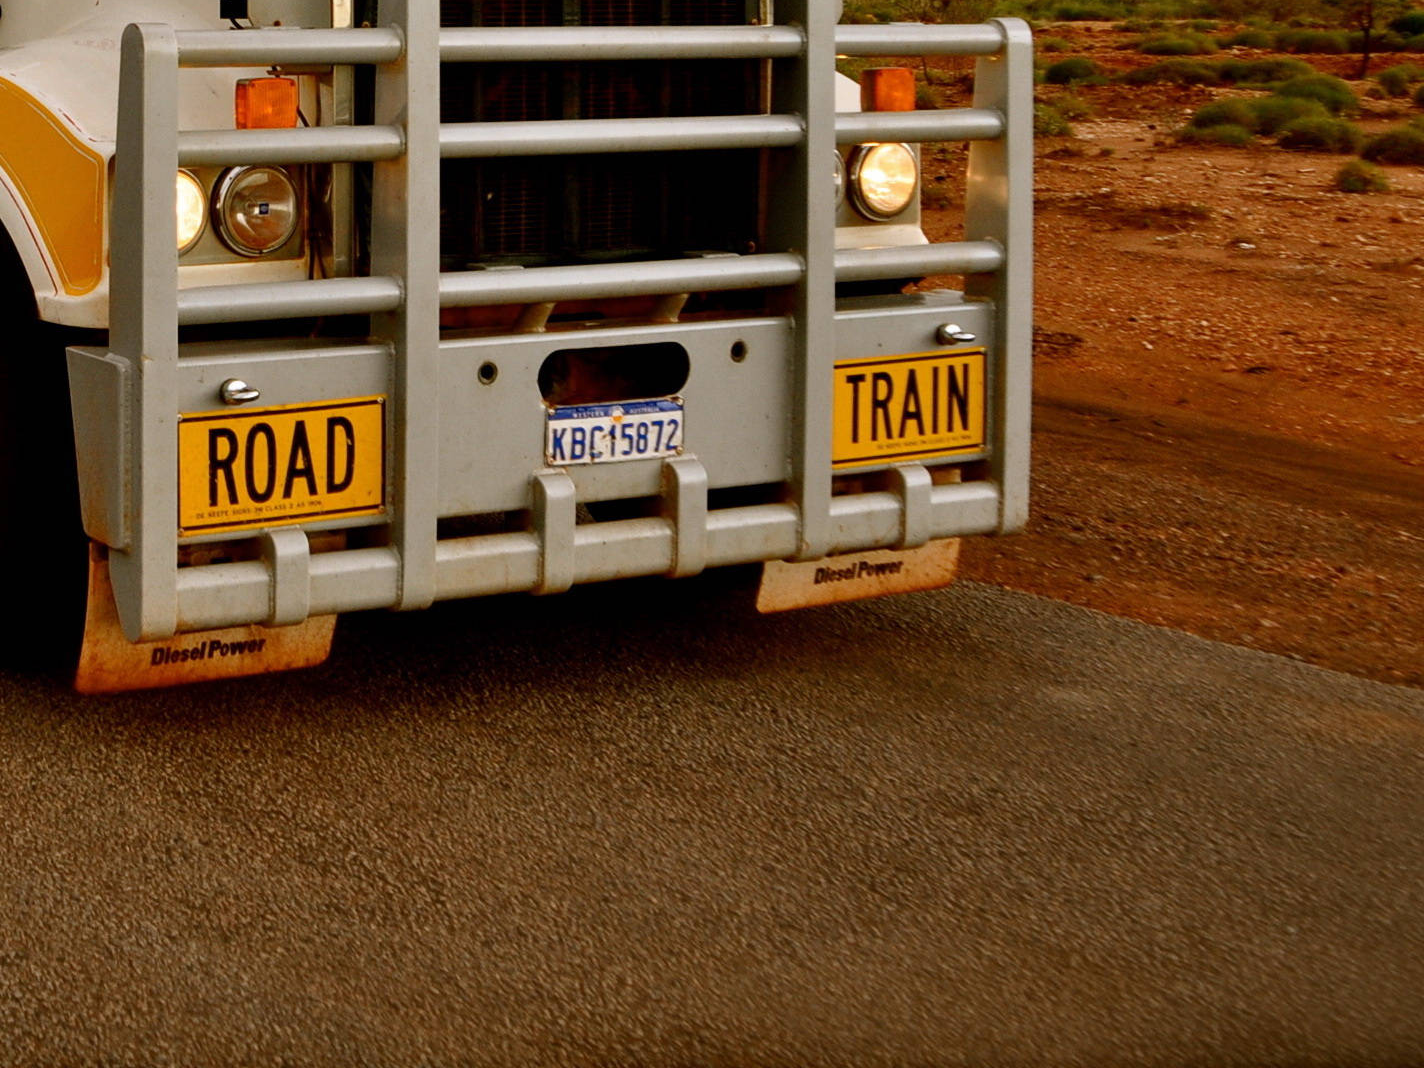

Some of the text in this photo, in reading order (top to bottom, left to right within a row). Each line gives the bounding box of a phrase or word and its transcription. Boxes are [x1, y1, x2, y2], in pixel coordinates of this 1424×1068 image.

[846, 363, 970, 443] TRAIN
[208, 416, 355, 507] ROAD
[814, 560, 904, 585] Diesel Power
[150, 638, 266, 666] Diesel Power
